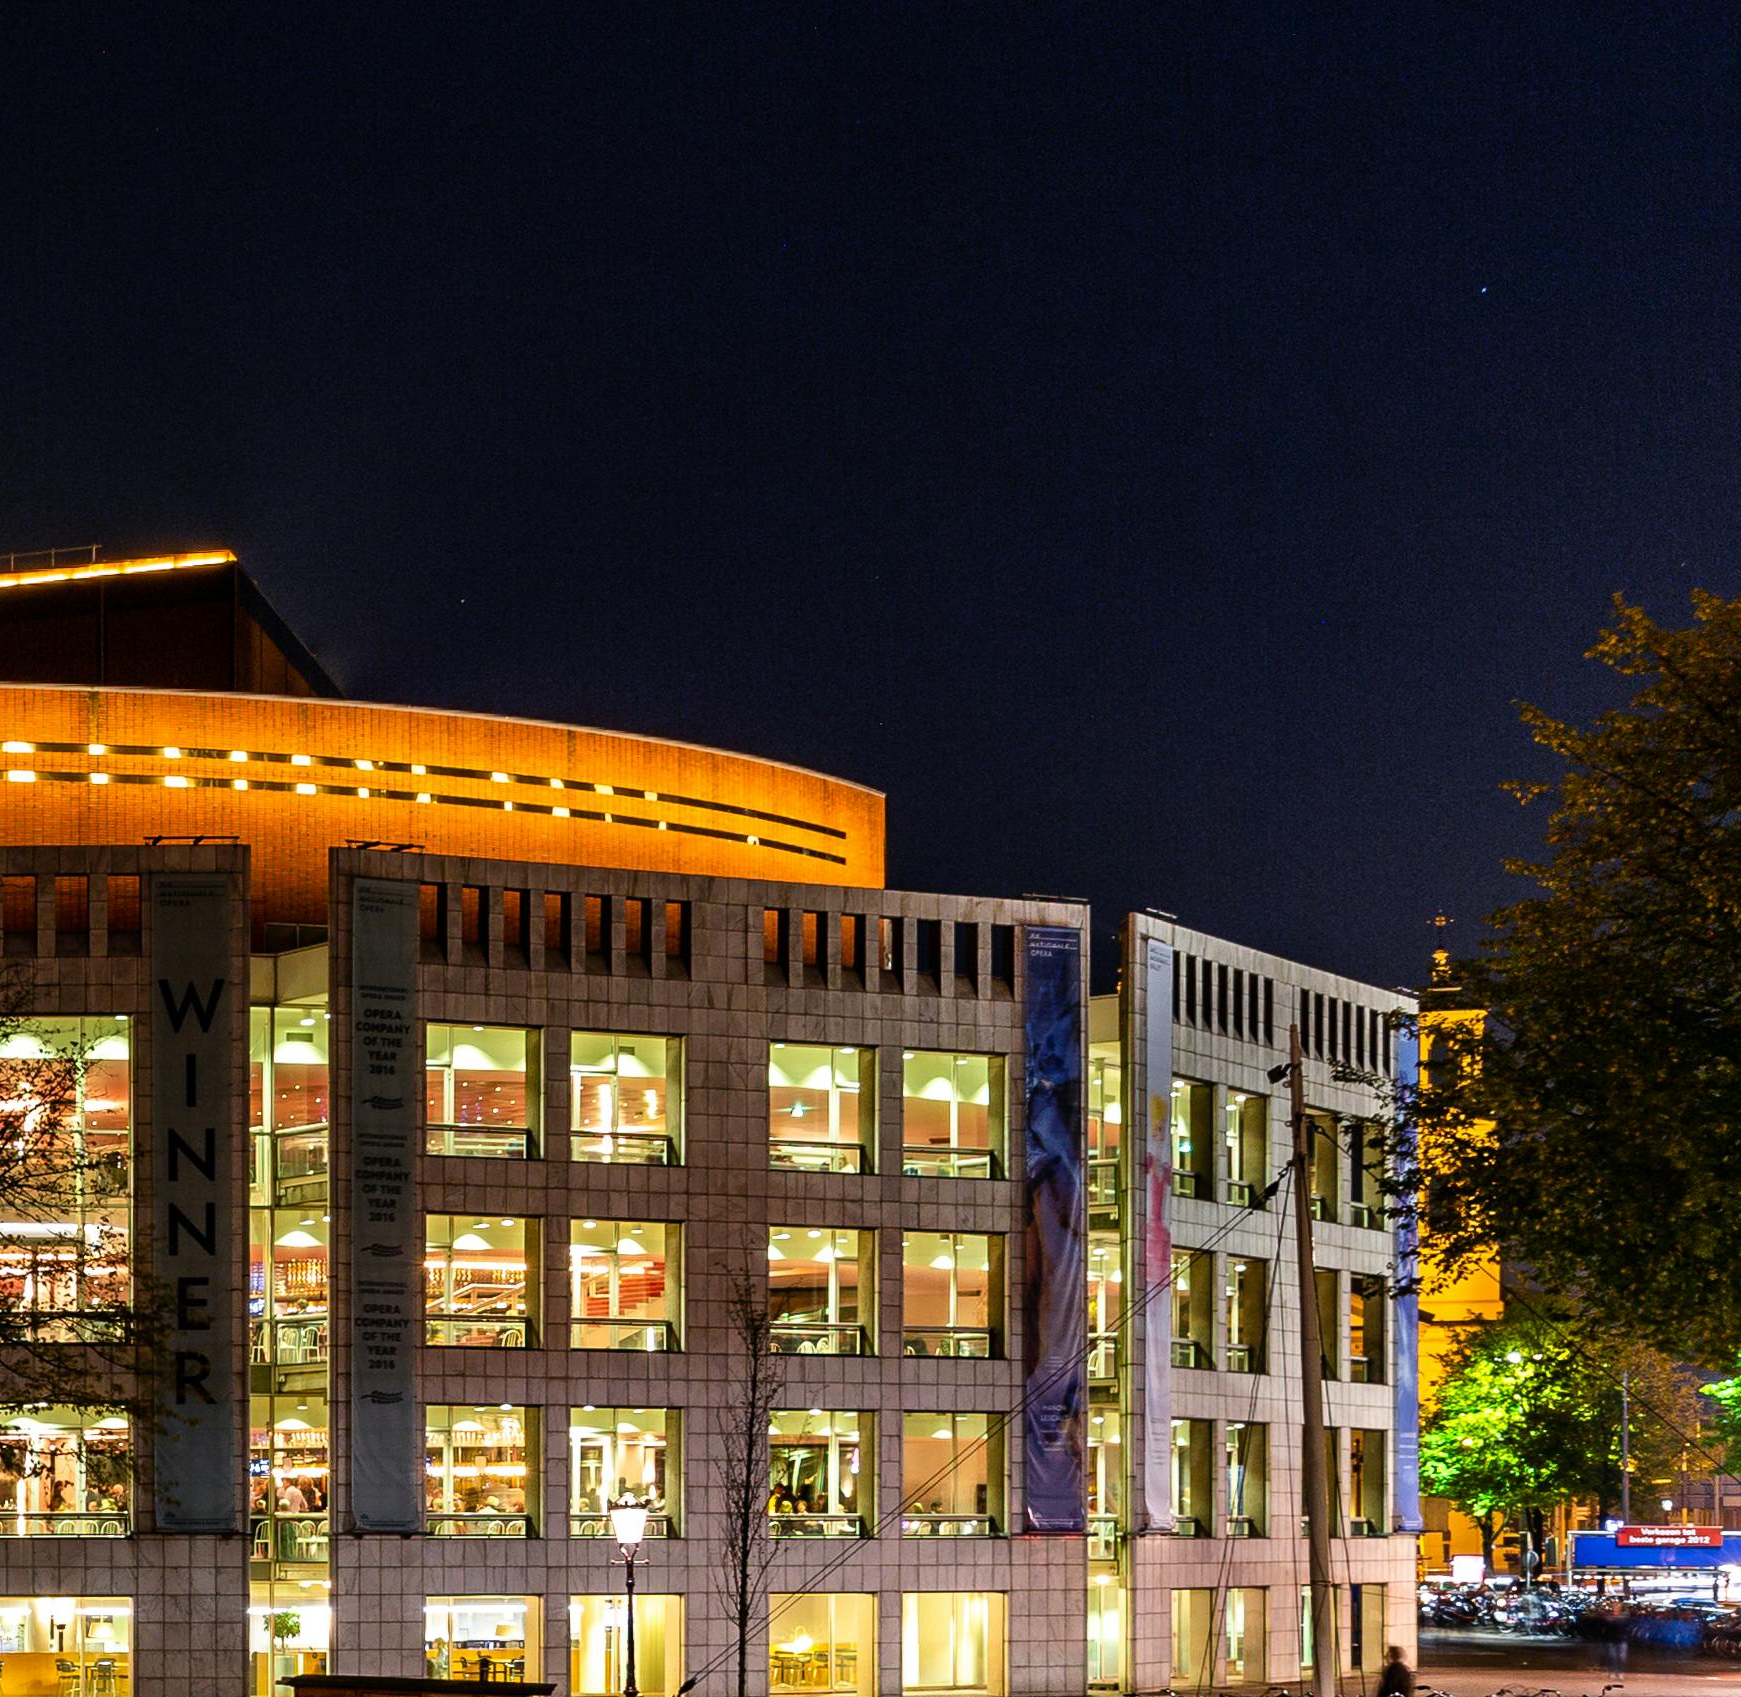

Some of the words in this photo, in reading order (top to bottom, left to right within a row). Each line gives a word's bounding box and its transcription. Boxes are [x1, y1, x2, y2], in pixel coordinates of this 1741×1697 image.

[364, 1008, 402, 1020] OPERA
[356, 1021, 411, 1034] COMPANY
[363, 1036, 377, 1046] OF
[380, 1038, 402, 1048] THE
[367, 1050, 397, 1062] YEAR
[369, 1064, 396, 1075] 2016
[363, 1156, 401, 1168] OPERA
[158, 978, 226, 1405] WINNER
[367, 1198, 397, 1209] YEAR
[363, 1303, 401, 1315] OPERA
[355, 1317, 410, 1329] COMPANY
[361, 1331, 378, 1342] OF
[380, 1332, 402, 1342] THE
[367, 1345, 397, 1356] YEAR
[368, 1359, 396, 1370] 2016
[1687, 1536, 1710, 1544] 2012
